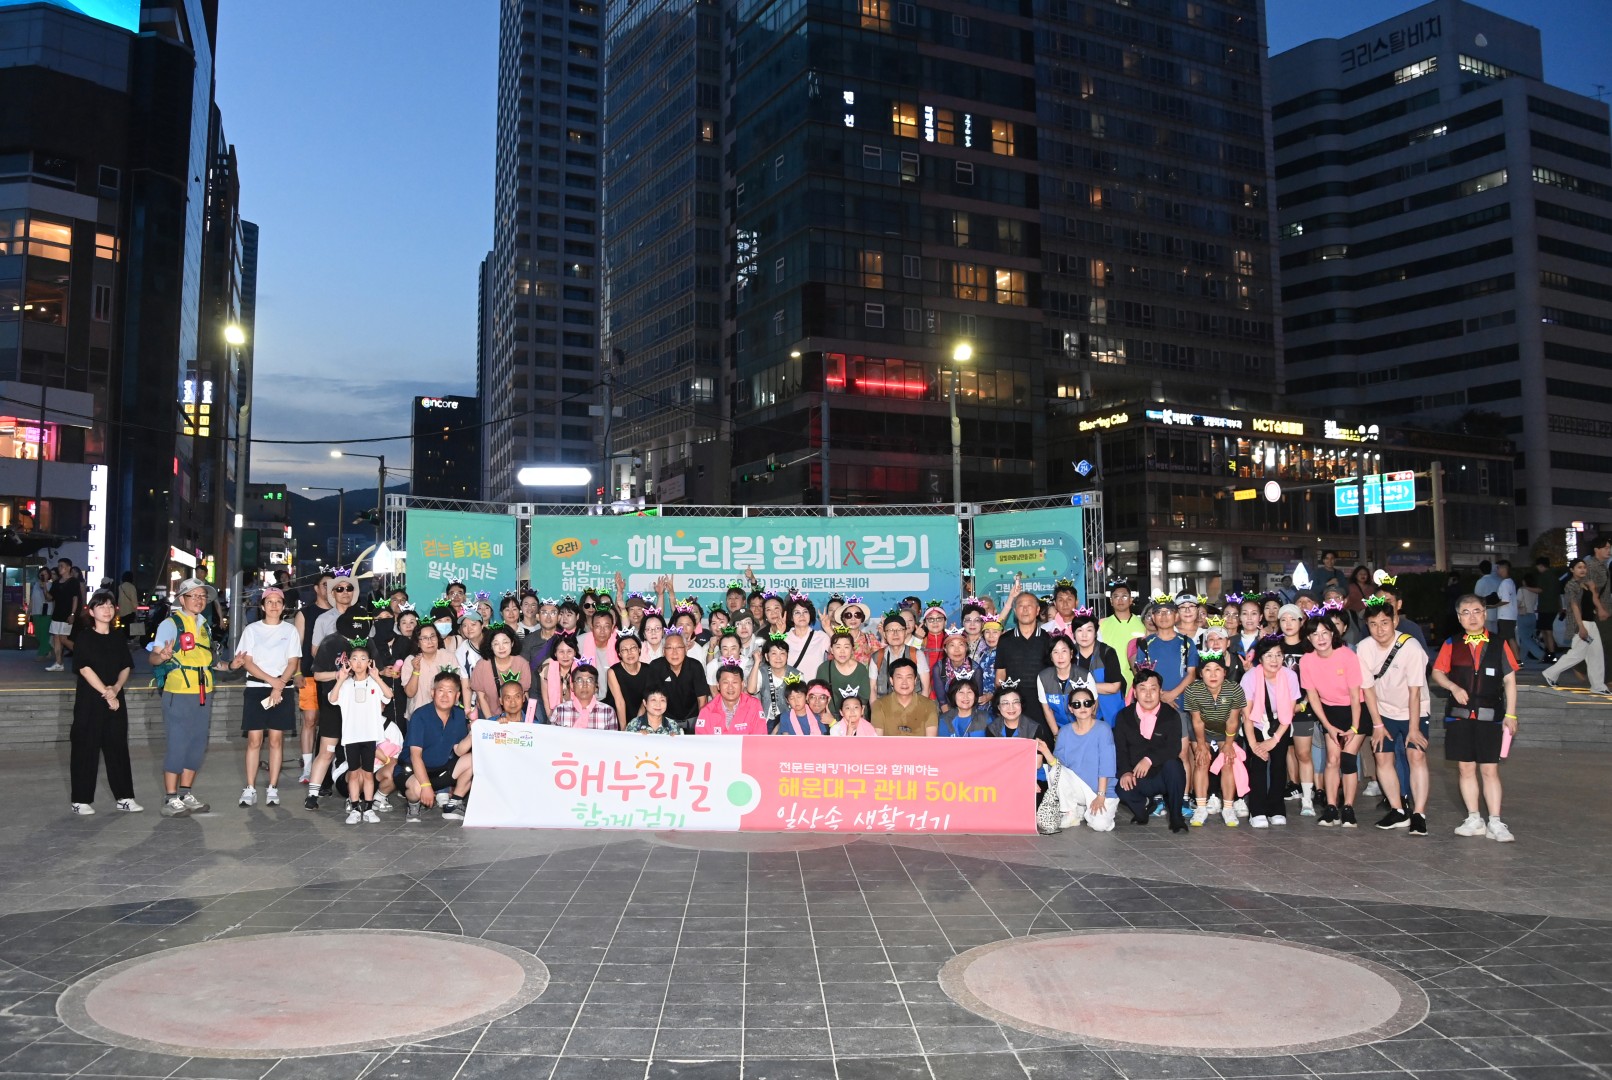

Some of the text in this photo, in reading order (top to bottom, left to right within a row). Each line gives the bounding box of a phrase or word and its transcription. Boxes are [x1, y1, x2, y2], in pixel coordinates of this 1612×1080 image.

[1340, 14, 1442, 73] 크리스탈비치
[422, 397, 459, 409] encore
[423, 540, 503, 559] 걷는 즐거움이
[556, 541, 578, 554] 오라!
[627, 534, 929, 570] 해누리길 함께 걷기
[428, 561, 498, 580] 일상이 되는
[561, 561, 600, 577] 낭만의
[801, 578, 870, 589] 해운대스퀘어
[778, 762, 939, 777] 전문트레킹가이드와 함께하는
[552, 752, 712, 812] 해누리길
[778, 776, 997, 803] 해운대구 관내 50km
[571, 802, 634, 827] 함께
[777, 802, 843, 830] 일상속
